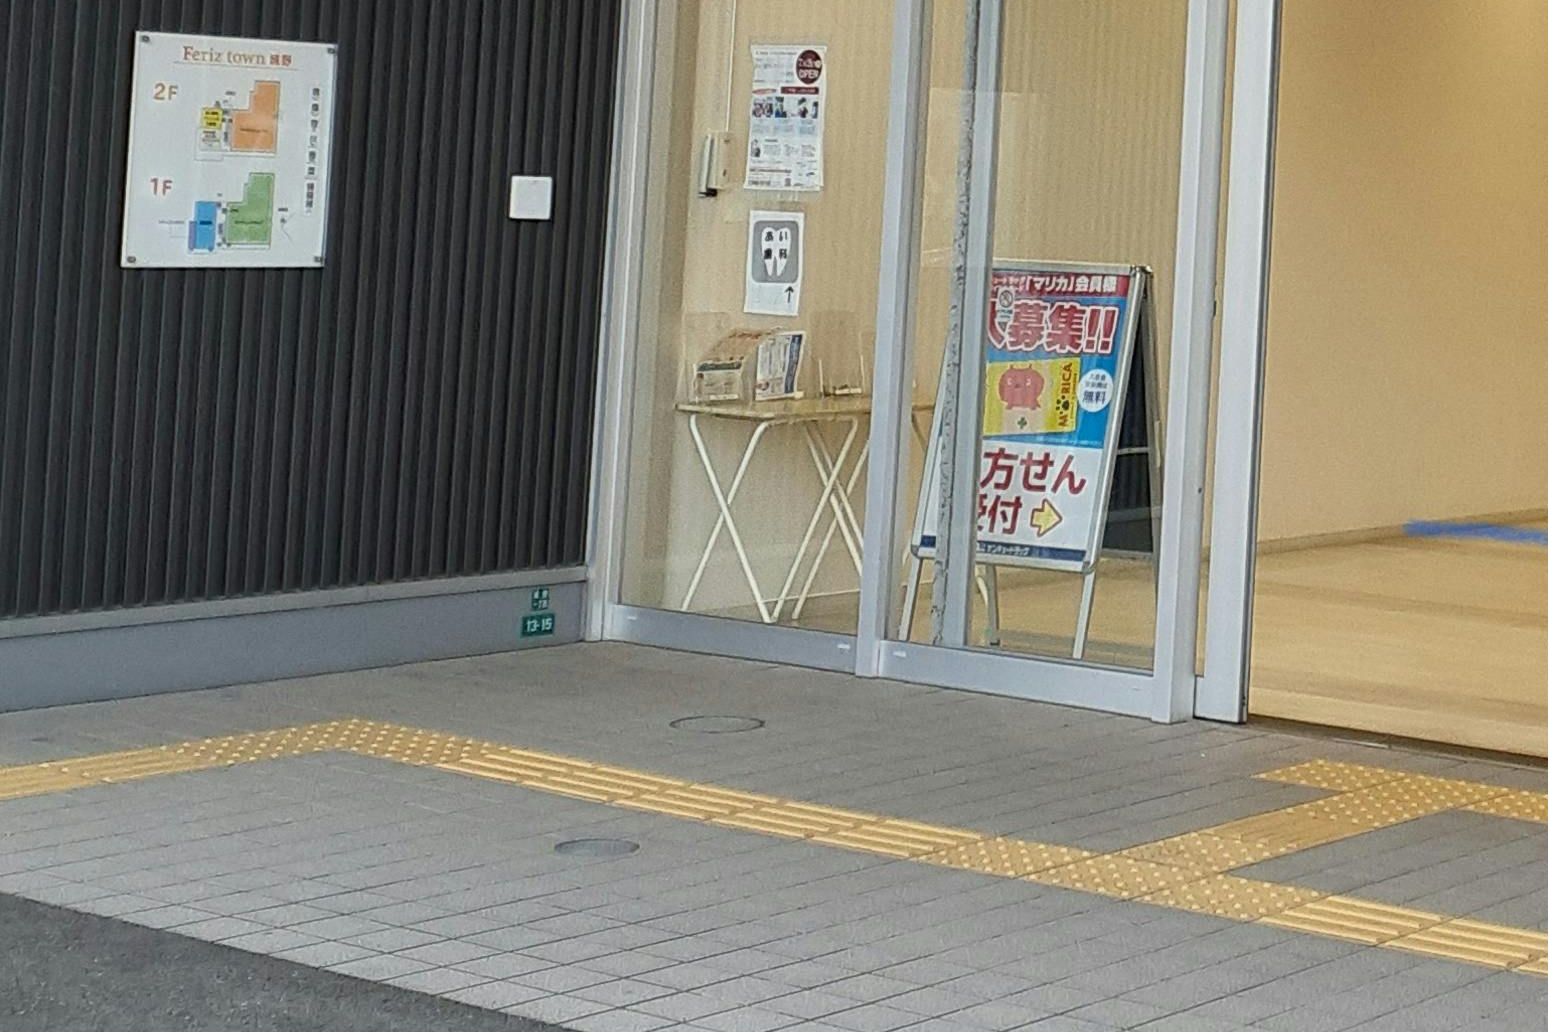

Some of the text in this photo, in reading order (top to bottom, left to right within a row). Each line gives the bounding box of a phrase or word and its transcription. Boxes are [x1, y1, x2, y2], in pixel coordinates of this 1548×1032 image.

[182, 45, 222, 63] Feriz
[227, 50, 266, 65] town
[153, 82, 179, 101] 2F
[150, 177, 173, 197] 1F
[526, 617, 553, 633] 13-15
